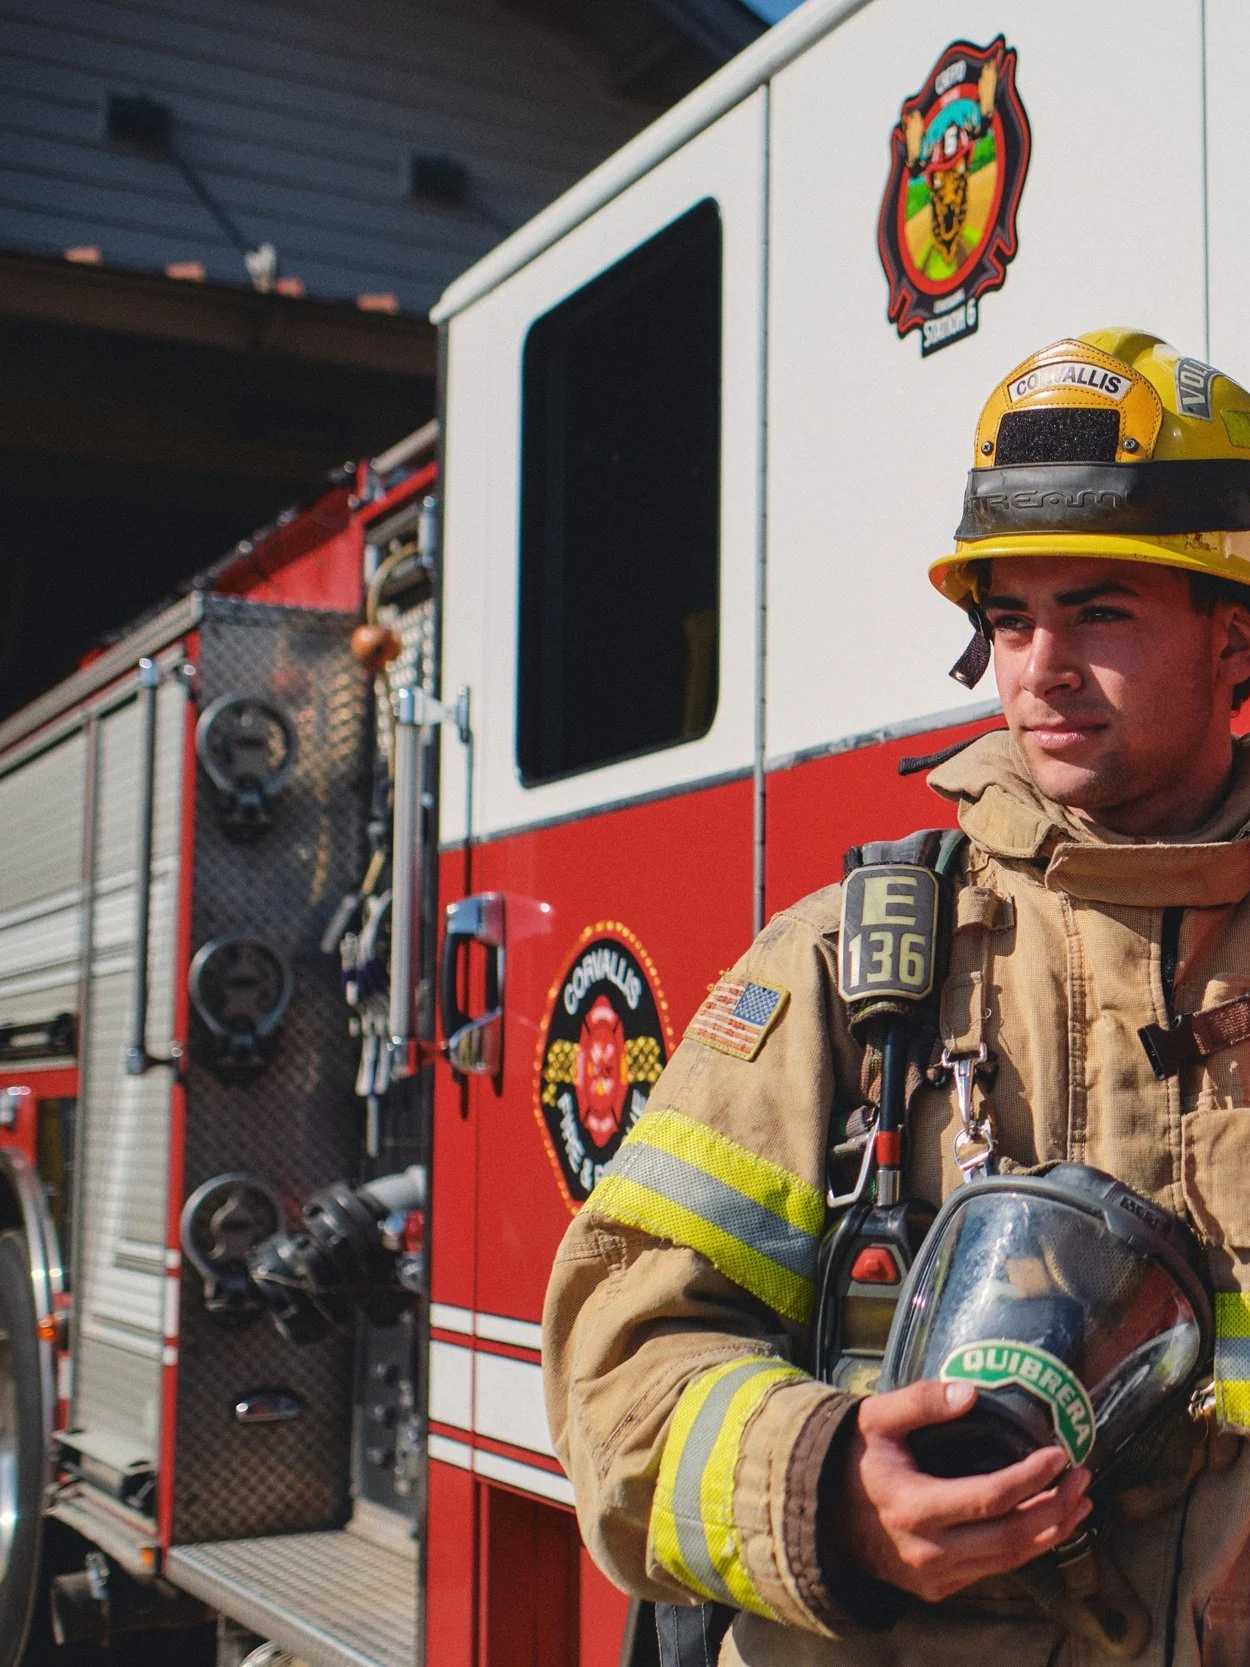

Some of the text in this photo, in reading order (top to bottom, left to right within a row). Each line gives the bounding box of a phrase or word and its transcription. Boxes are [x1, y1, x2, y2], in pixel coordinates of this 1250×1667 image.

[860, 875, 918, 927] E
[563, 948, 643, 1016] CORVALLIS
[848, 931, 926, 988] 136
[962, 1348, 1091, 1446] QUIBRERA
